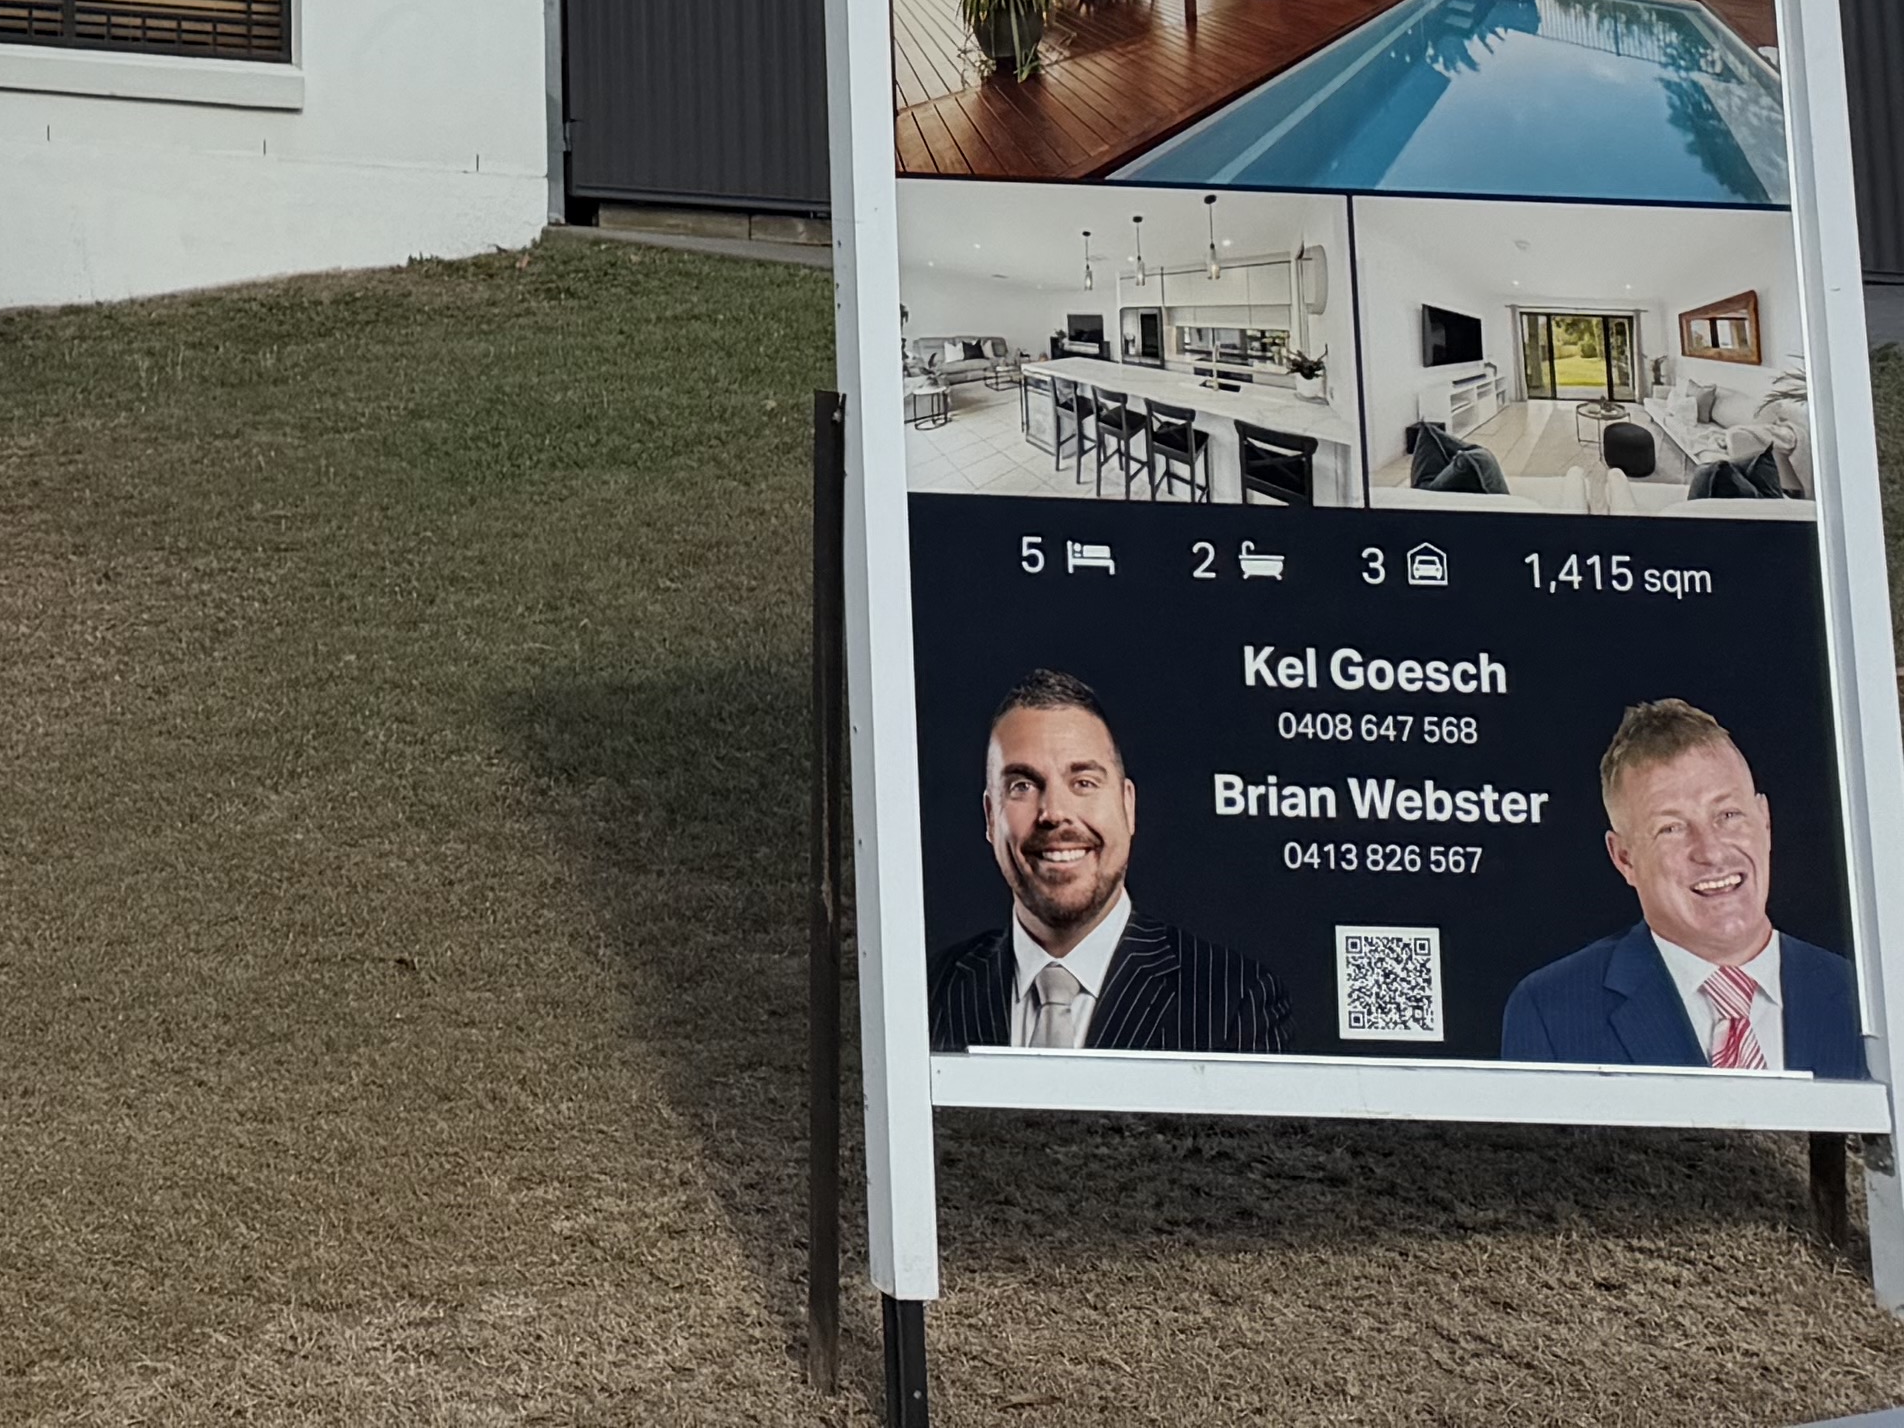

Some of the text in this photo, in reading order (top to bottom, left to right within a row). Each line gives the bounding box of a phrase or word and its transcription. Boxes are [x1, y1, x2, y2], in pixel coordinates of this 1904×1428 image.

[1021, 536, 1712, 600] 5 2 3 1,415 sqm
[1243, 645, 1507, 694] Kel Goesch
[1278, 711, 1478, 744] 0408 647 568
[1214, 773, 1549, 824] Brian Webster
[1283, 841, 1483, 874] 0413 826 567
